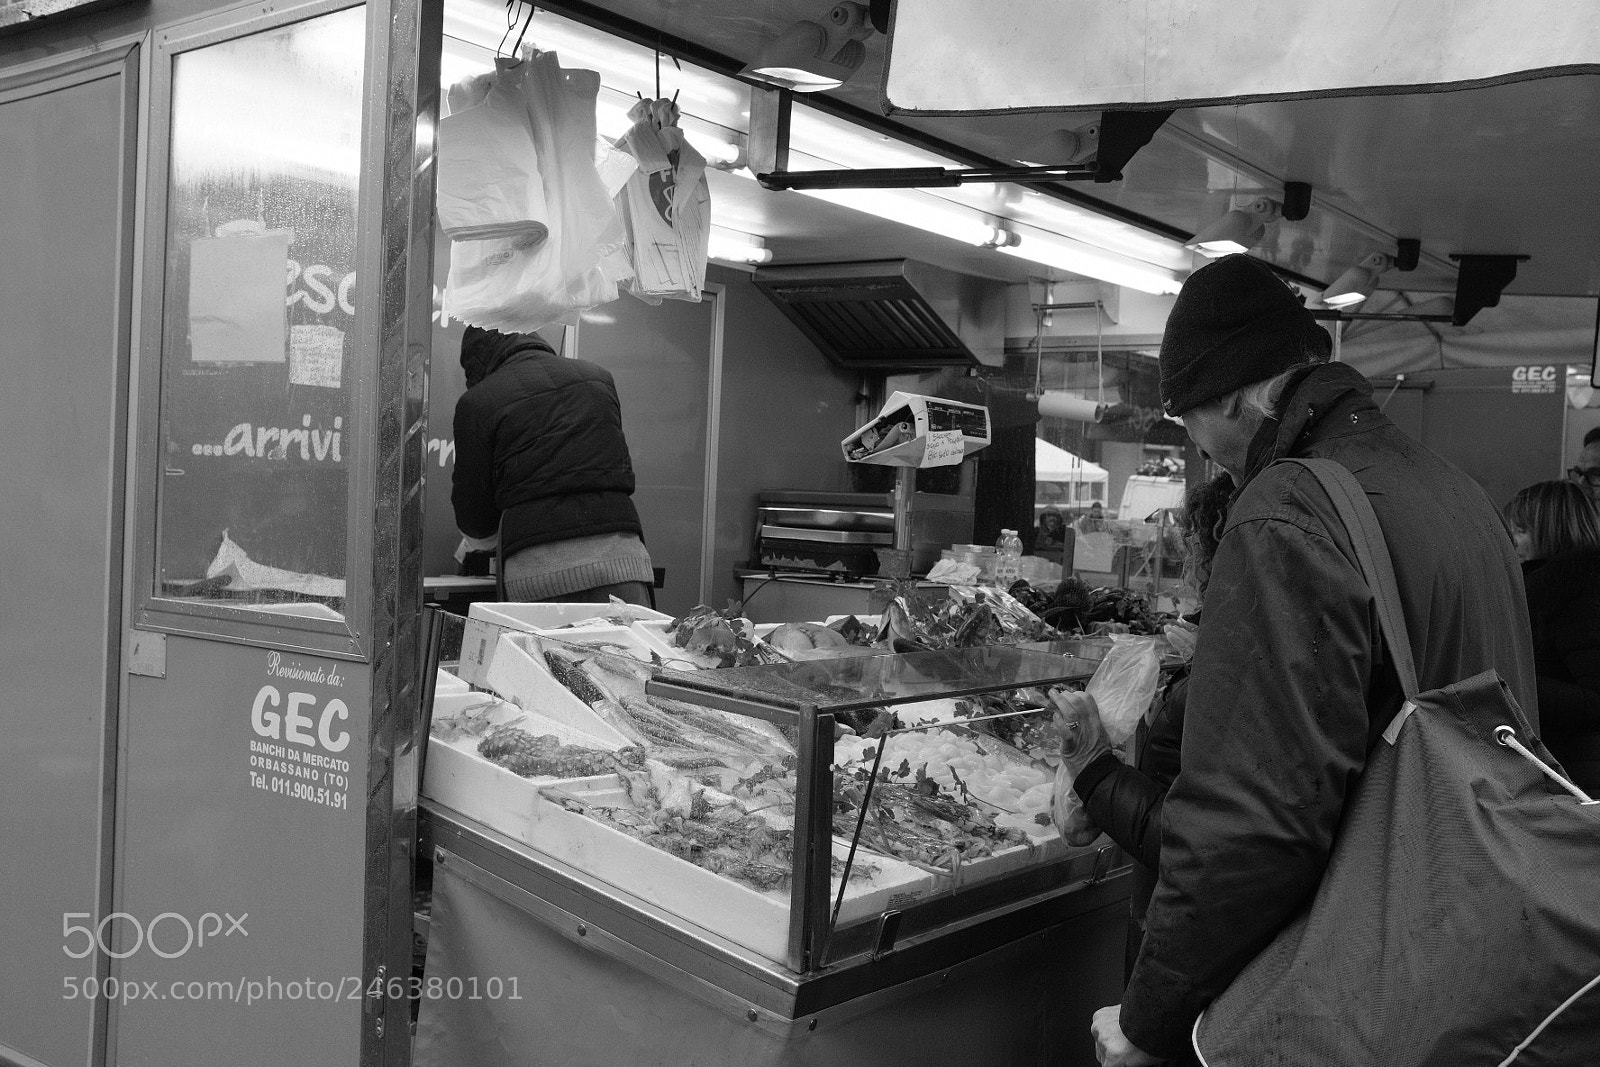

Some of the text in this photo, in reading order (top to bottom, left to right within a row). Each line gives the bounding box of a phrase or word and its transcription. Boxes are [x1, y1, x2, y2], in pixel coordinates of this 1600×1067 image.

[1512, 366, 1556, 381] GEC
[267, 650, 345, 687] Revisionato da:
[251, 685, 350, 752] GEC
[250, 740, 349, 773] BANCHI DA MERCATO
[250, 756, 349, 791] ORBASSANO (TO)
[250, 771, 347, 810] Tel. 011.900.51.91
